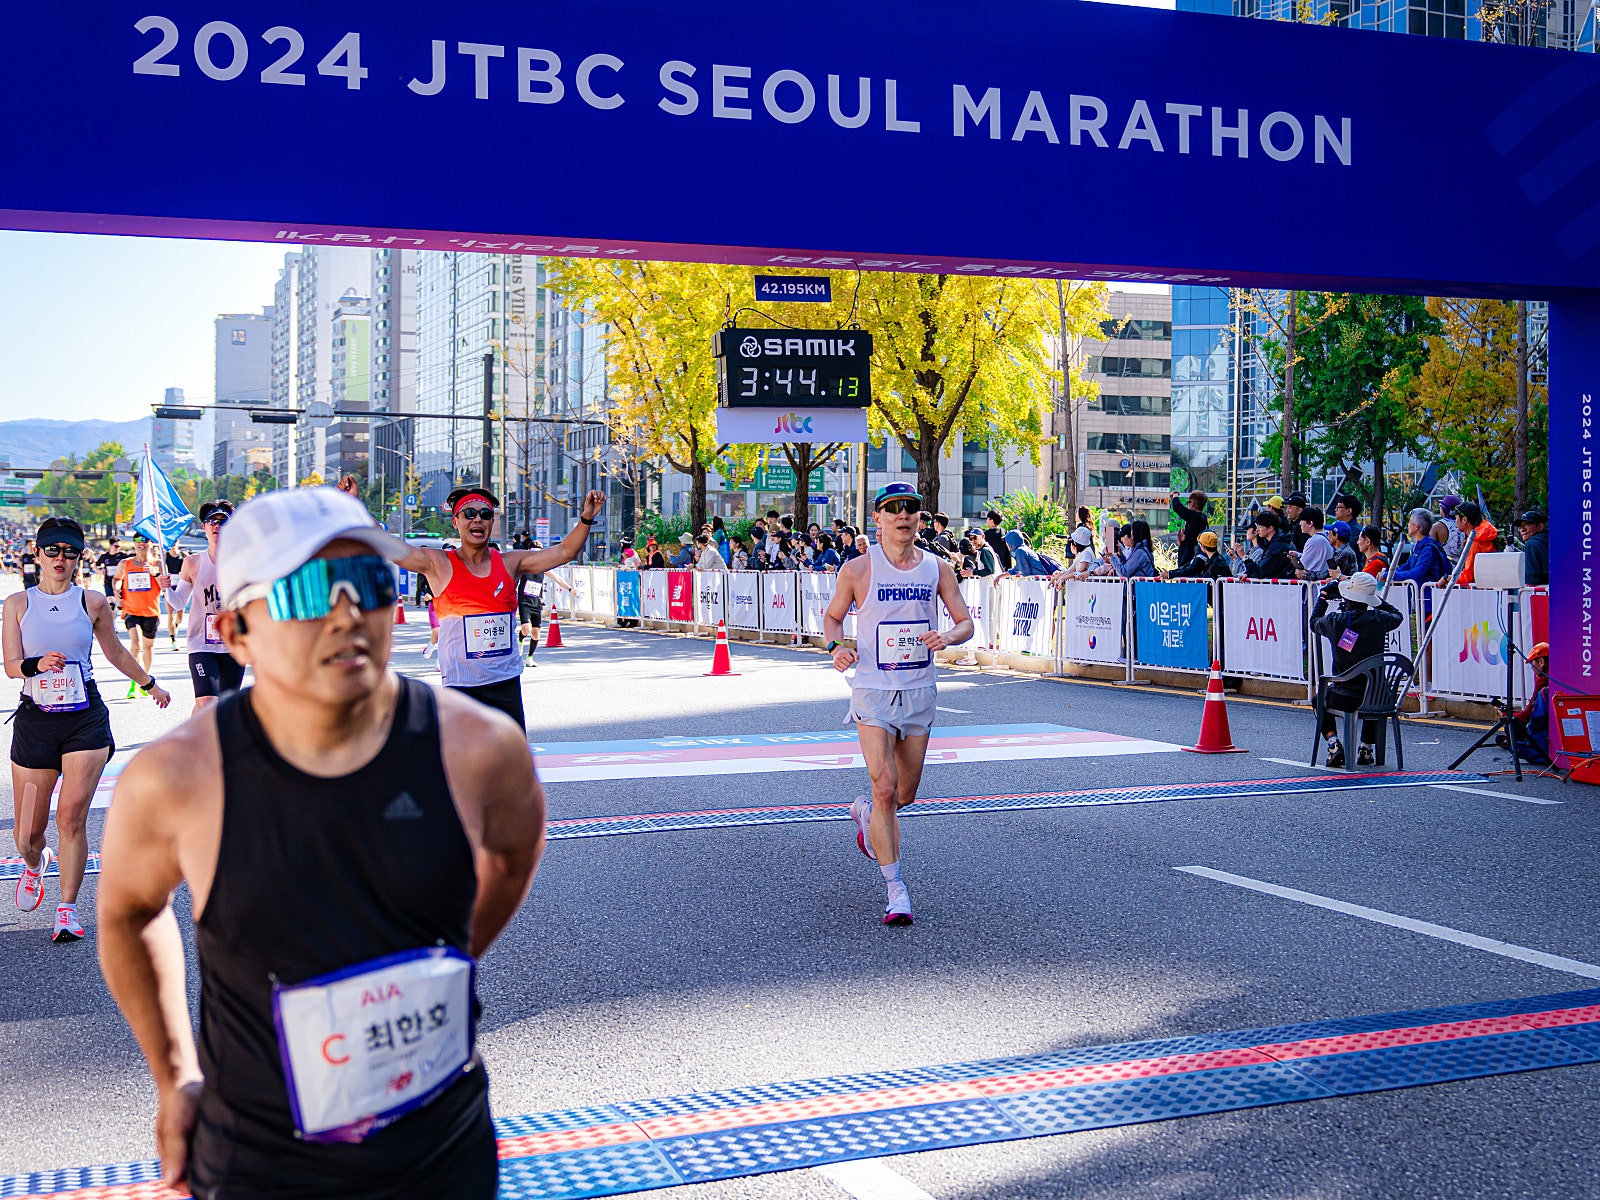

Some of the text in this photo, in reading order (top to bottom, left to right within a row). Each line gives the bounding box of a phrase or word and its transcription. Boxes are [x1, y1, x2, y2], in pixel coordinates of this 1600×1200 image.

[132, 15, 1352, 166] 2024 JTBC SEOUL MARATHON
[761, 283, 826, 295] 42.195KM
[764, 338, 856, 356] SAMIK
[1582, 394, 1592, 677] 2024 JTBC SEOUL MARATHON
[772, 594, 786, 608] AIA
[878, 588, 931, 601] OPENCARE
[1149, 601, 1191, 627] 이온더핏
[473, 628, 481, 637] E
[1012, 618, 1032, 637] VITAL
[1245, 616, 1278, 642] AIA
[886, 637, 895, 647] C
[1162, 629, 1180, 648] 제로
[40, 679, 48, 689] E
[360, 982, 402, 1009] AIA
[321, 1033, 351, 1066] C
